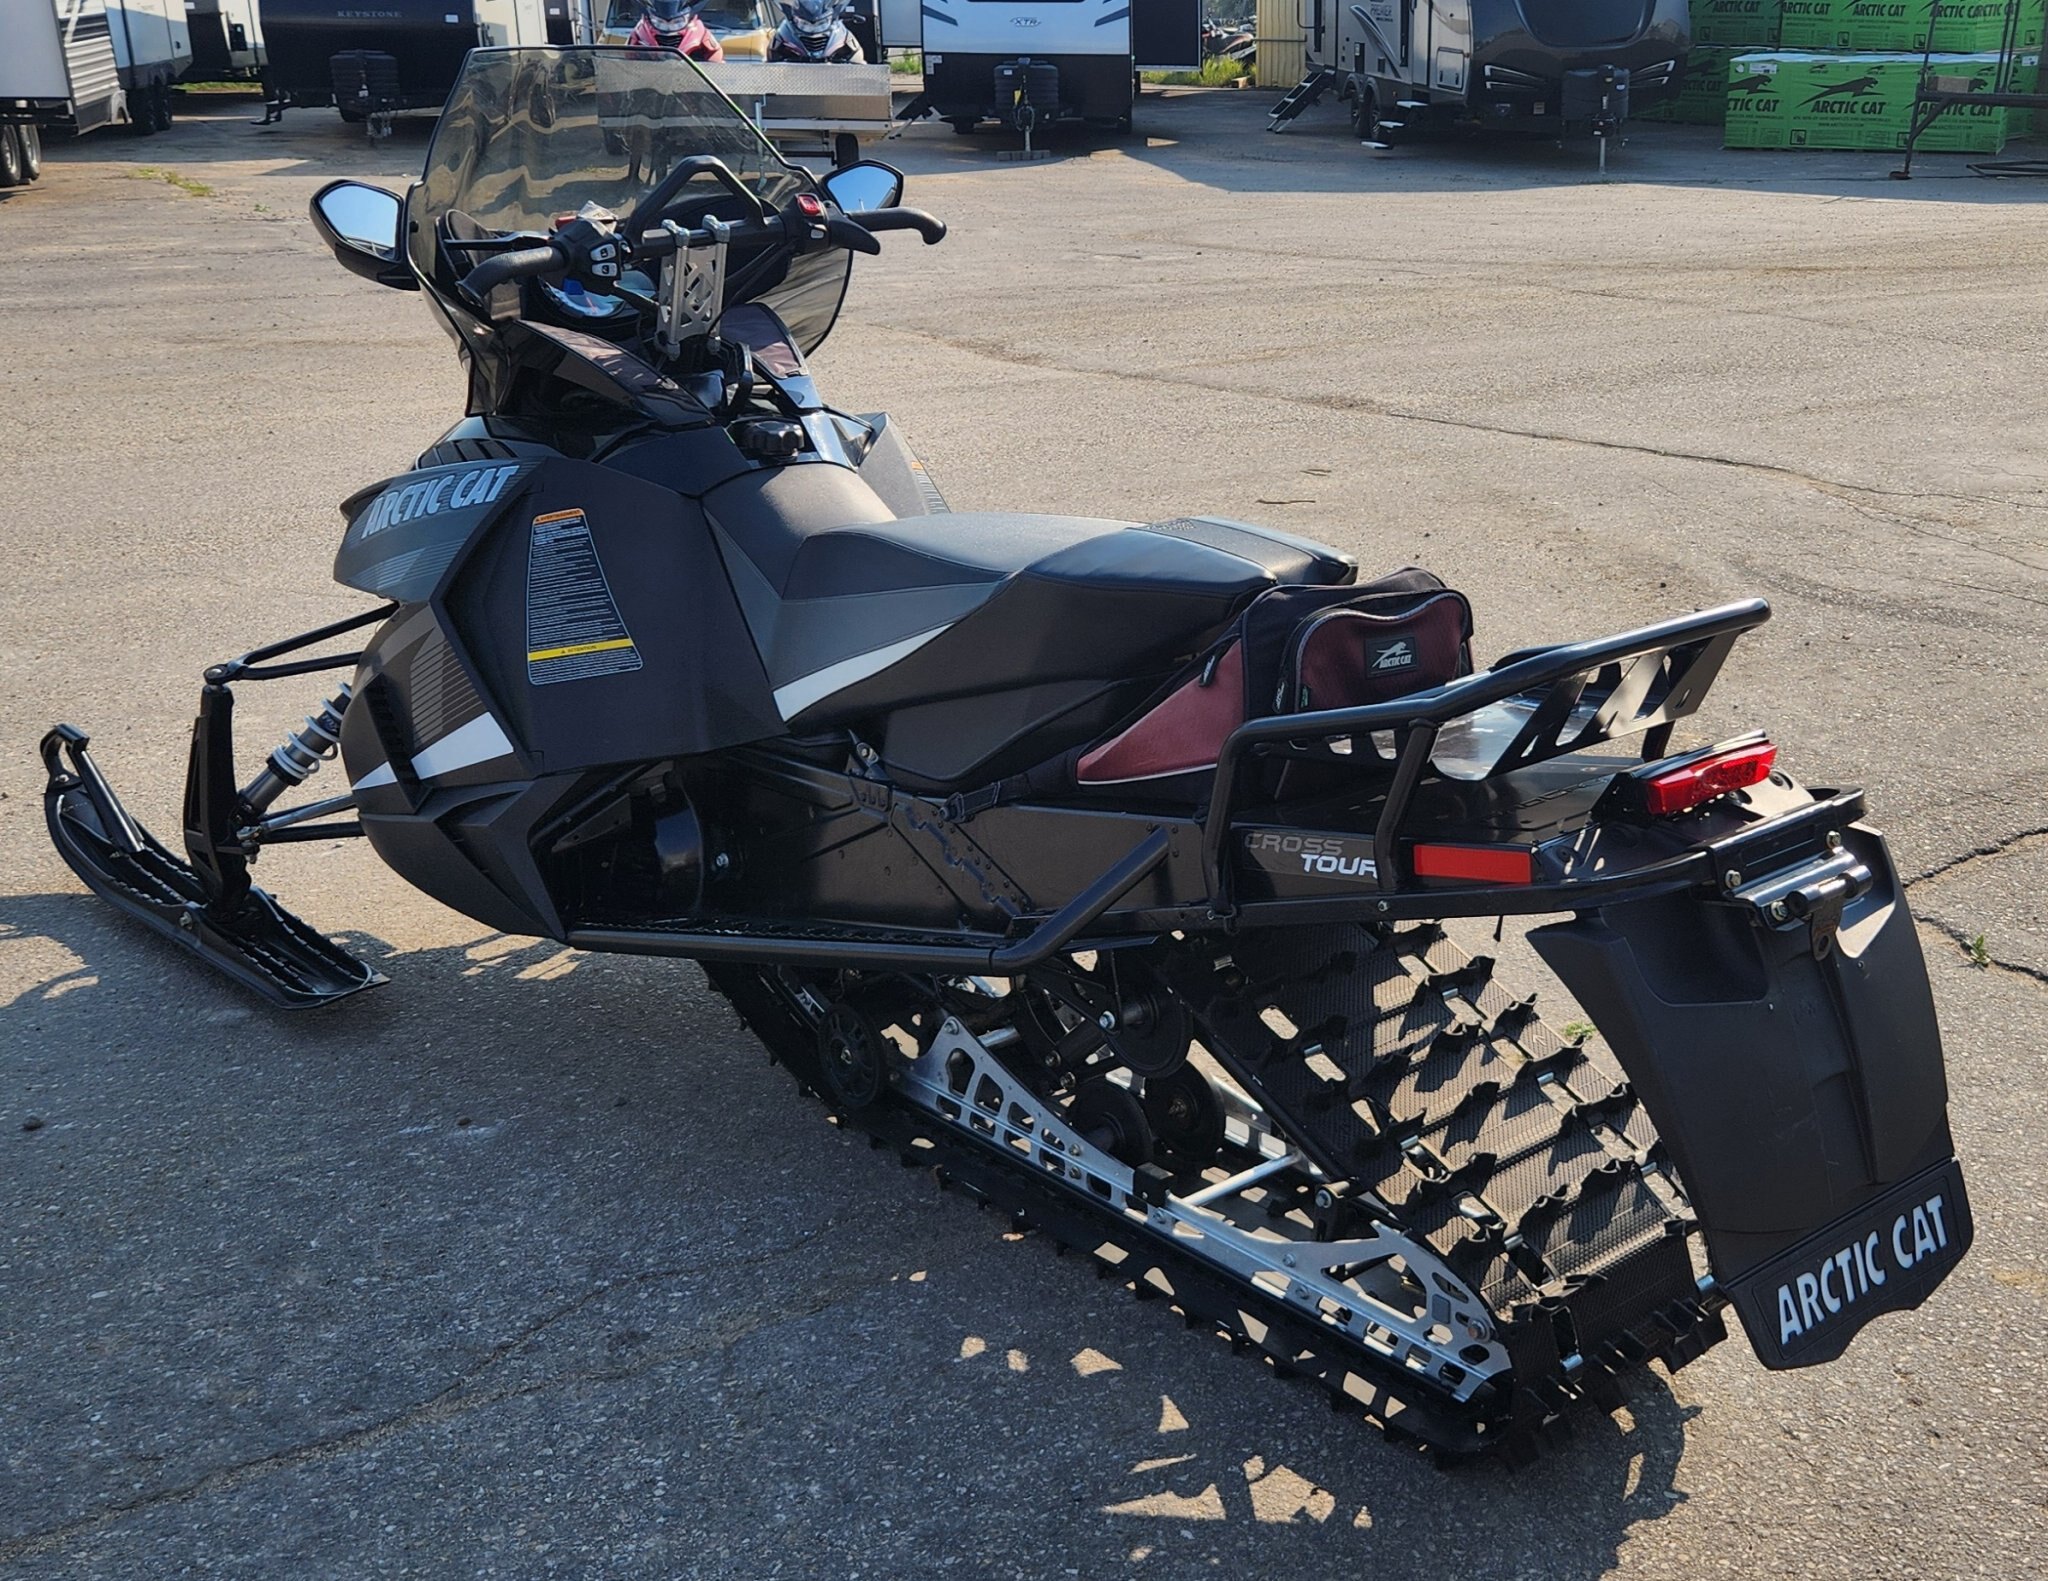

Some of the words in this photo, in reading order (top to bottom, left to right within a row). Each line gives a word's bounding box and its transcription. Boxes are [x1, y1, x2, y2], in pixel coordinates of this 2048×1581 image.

[337, 10, 402, 18] KEYSTONE
[1814, 3, 1831, 15] CAT
[1852, 4, 1885, 17] ARCTIC
[1887, 5, 1906, 17] CAT
[1755, 99, 1780, 112] CAT
[1811, 100, 1858, 114] ARCTIC
[1861, 101, 1887, 115] CAT
[361, 475, 455, 539] ARCTIC
[450, 465, 520, 509] CAT
[1379, 656, 1400, 668] ARCTIC
[1400, 654, 1412, 665] CAT
[1244, 832, 1344, 856] CROSS
[1301, 853, 1378, 880] TOUR
[1778, 1230, 1886, 1345] ARCTIC
[1892, 1194, 1948, 1269] CAT
